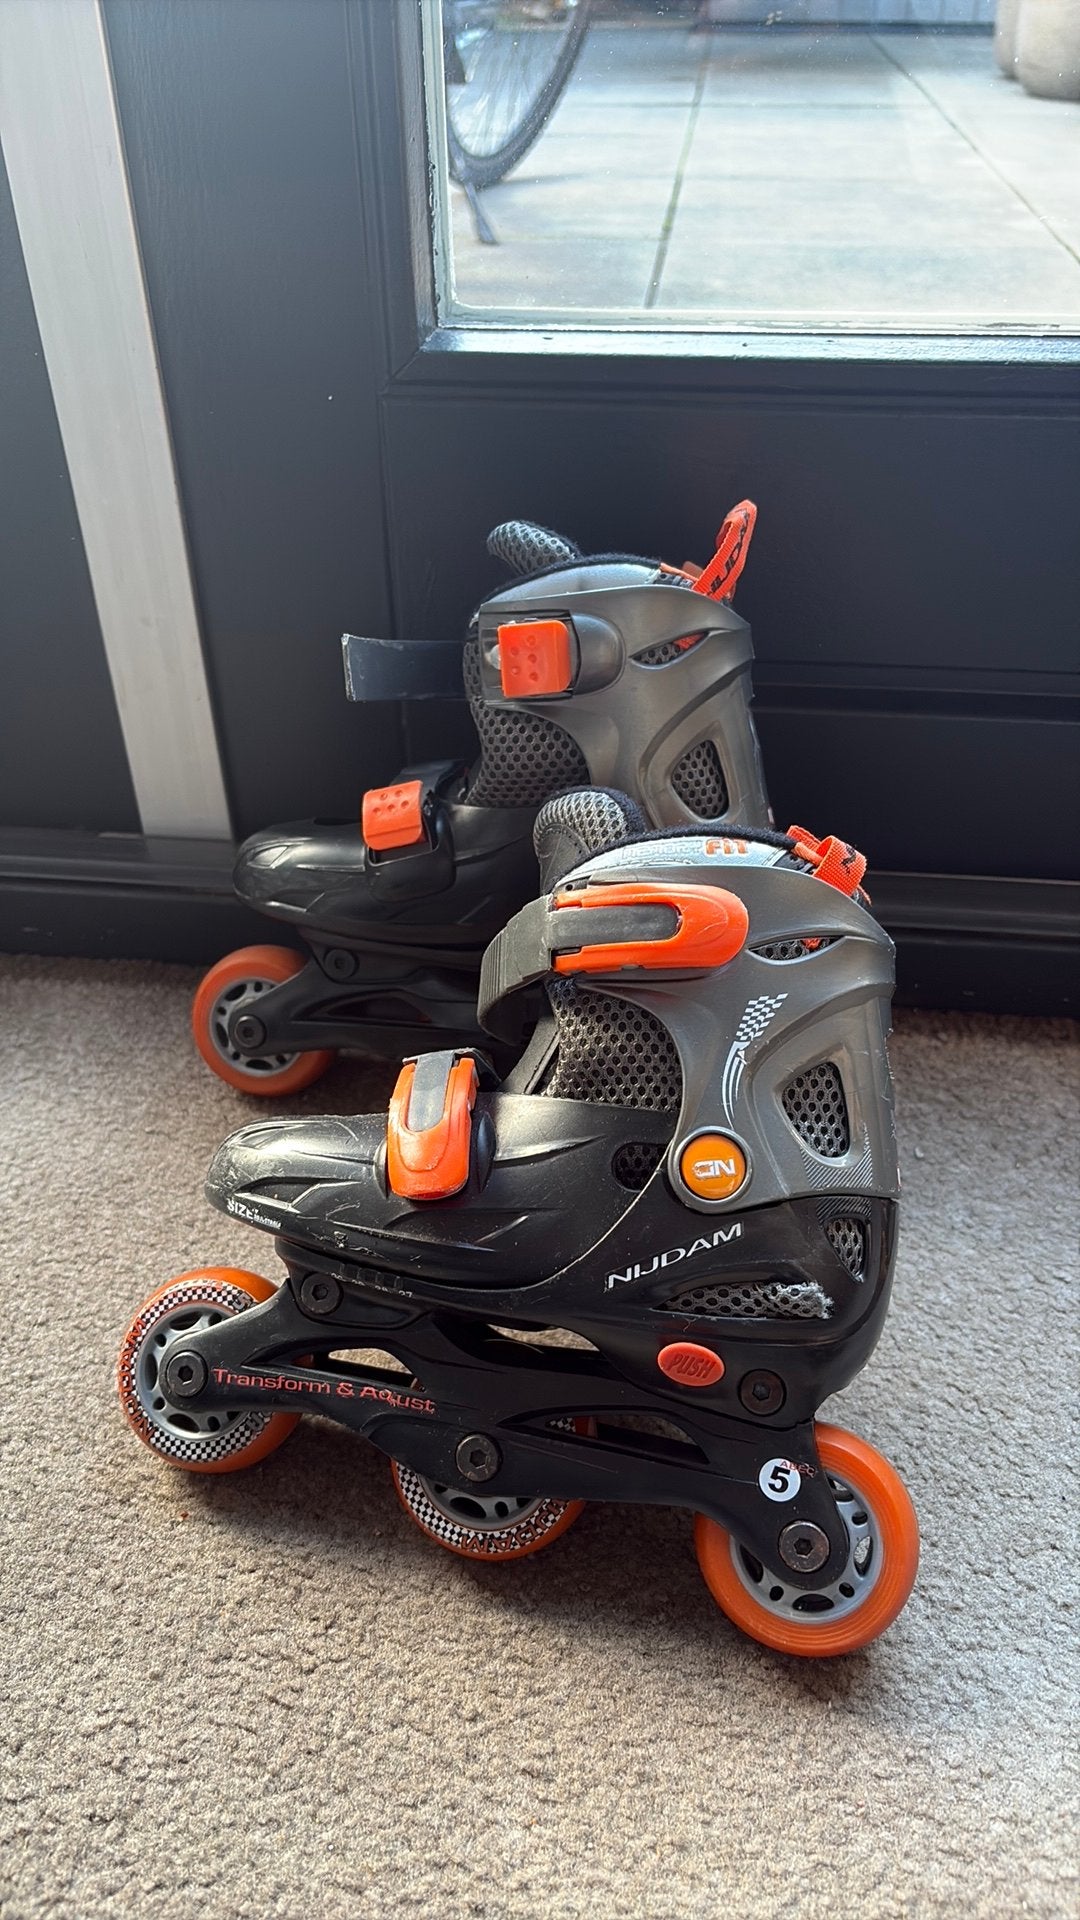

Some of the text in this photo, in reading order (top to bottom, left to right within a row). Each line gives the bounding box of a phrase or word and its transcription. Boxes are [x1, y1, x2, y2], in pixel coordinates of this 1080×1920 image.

[607, 1222, 742, 1289] NIJDAM
[119, 1319, 155, 1441] NIJDAM
[665, 1353, 717, 1379] PUSH
[212, 1367, 331, 1394] Transform
[336, 1382, 355, 1398] &
[767, 1465, 791, 1494] 5
